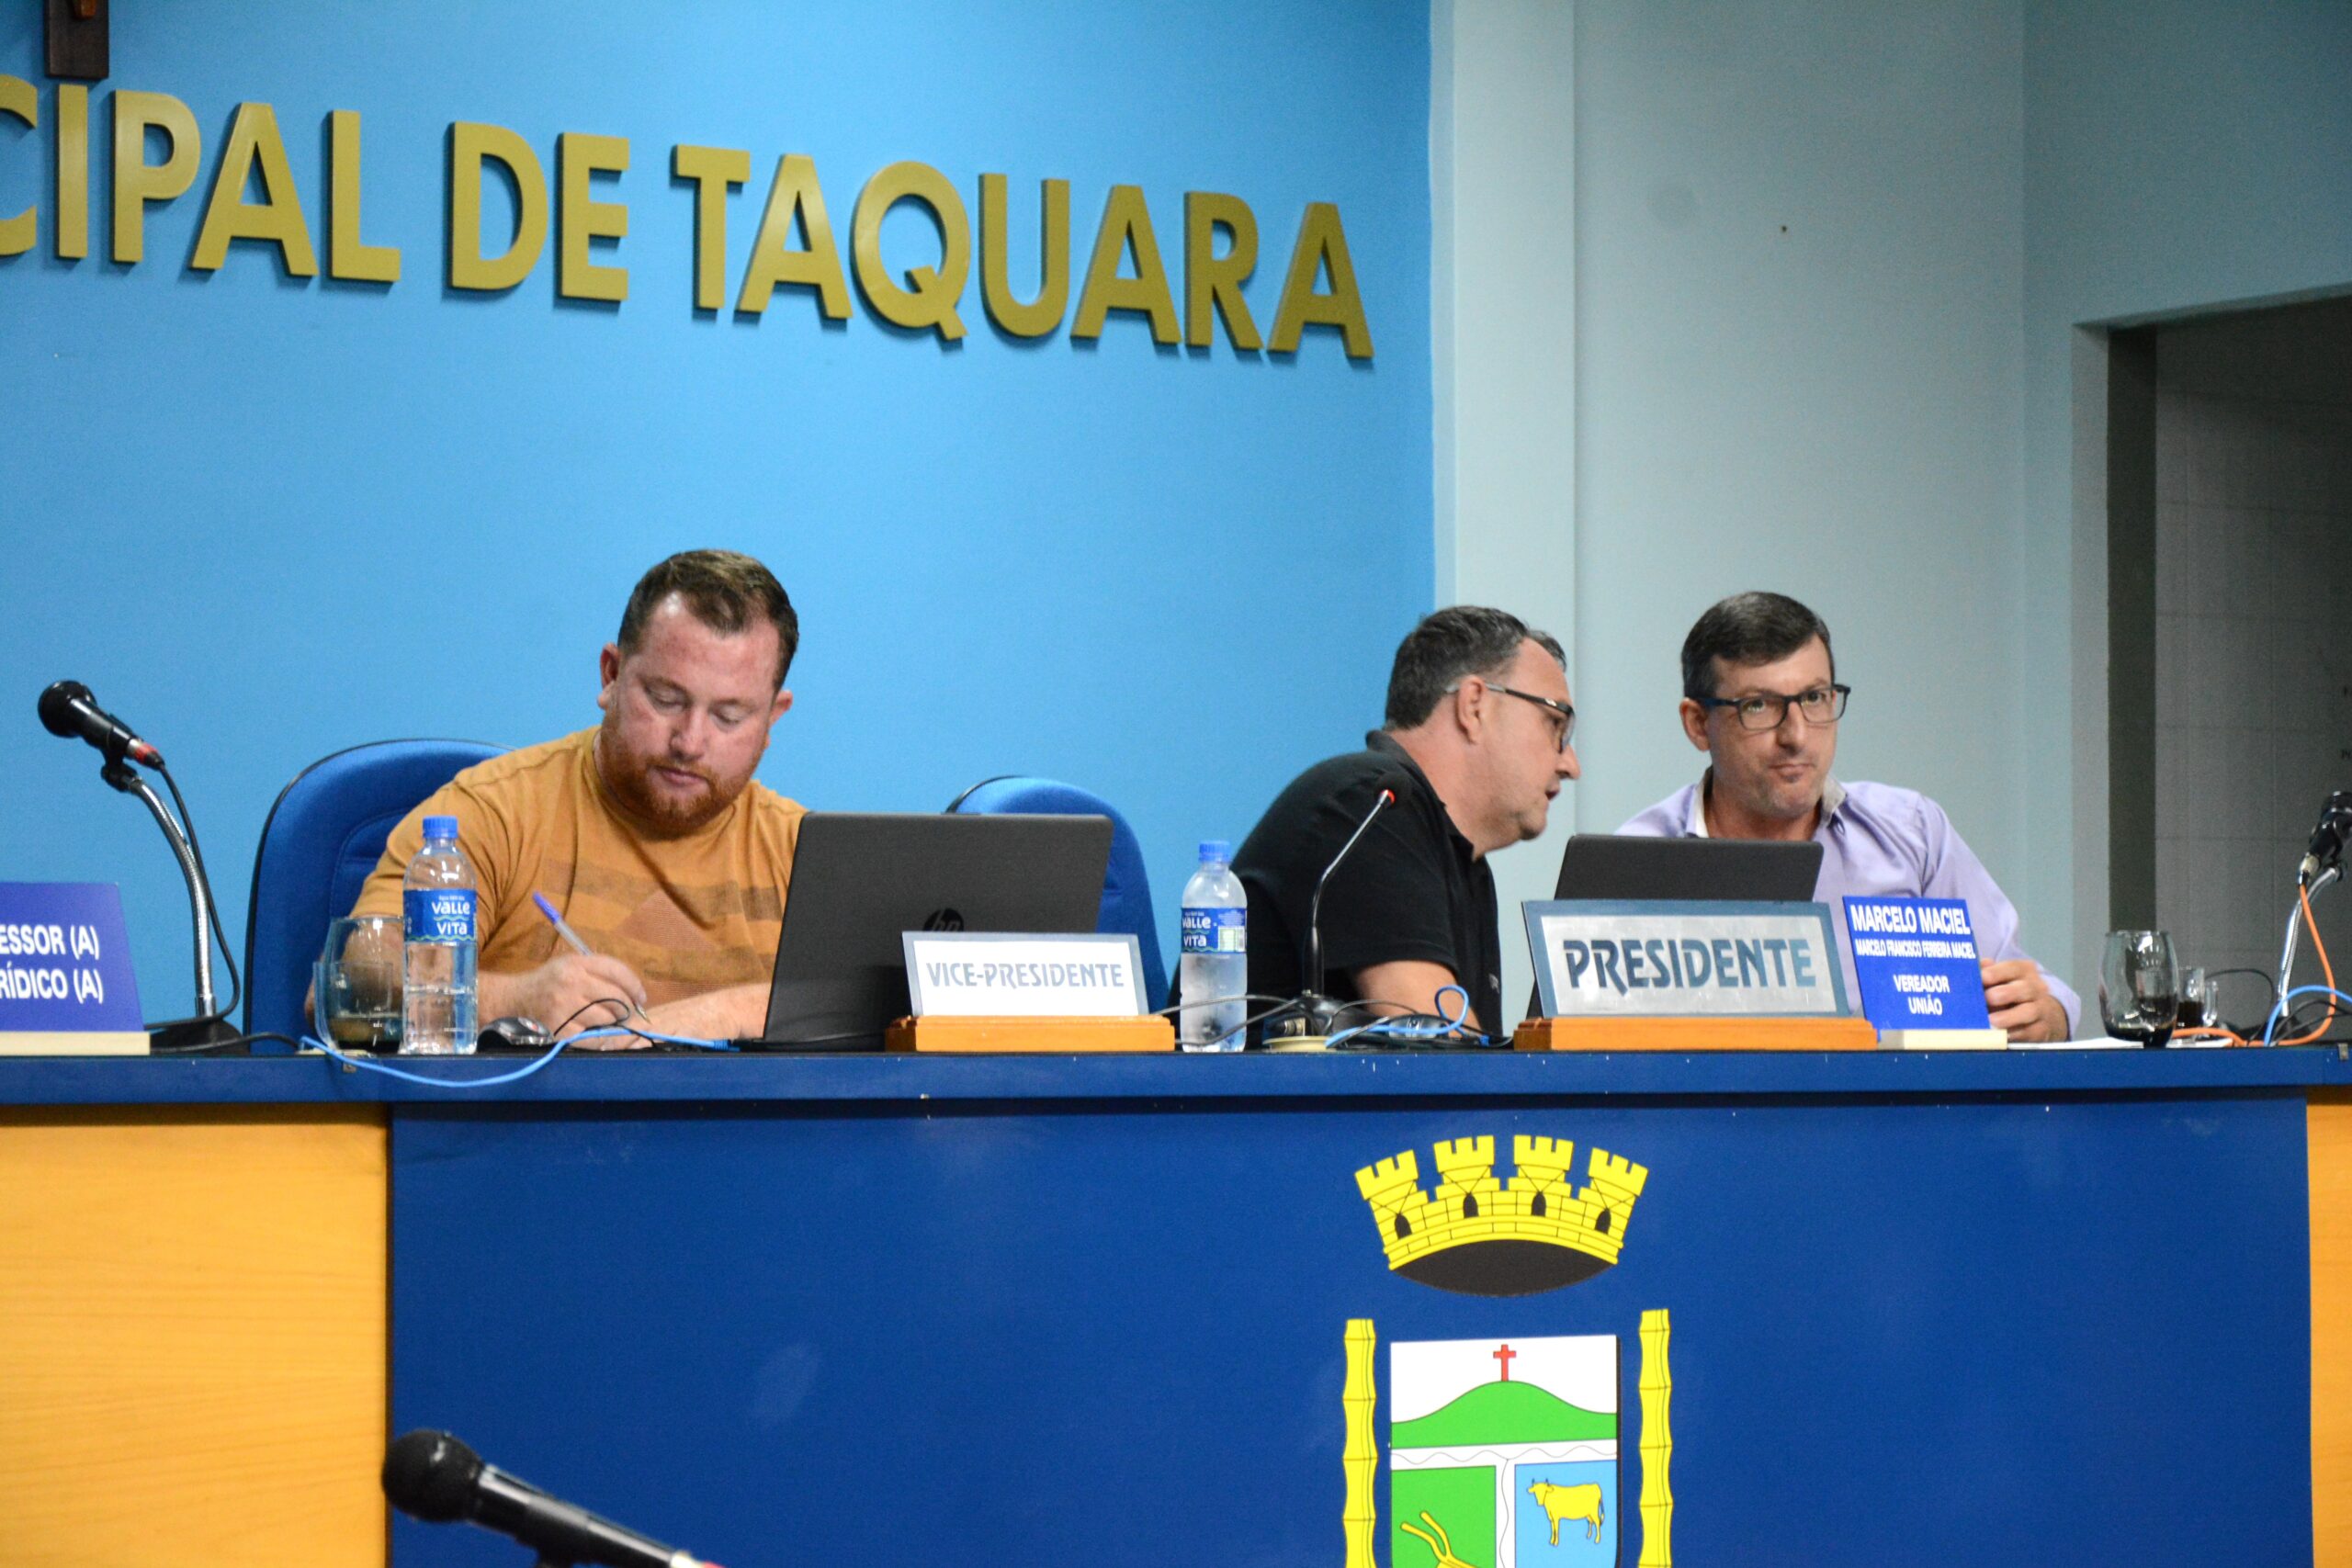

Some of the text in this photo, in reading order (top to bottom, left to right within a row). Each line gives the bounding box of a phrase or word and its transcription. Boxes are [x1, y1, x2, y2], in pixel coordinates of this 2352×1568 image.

[448, 120, 630, 301] DE
[672, 144, 1374, 358] TAQUARA
[1850, 905, 1971, 935] MARCELO MACIEL
[0, 924, 99, 961] ESSOR (A)
[1855, 939, 1976, 959] MARCELO FRANCISCO FERREIRA MACIEL
[0, 960, 104, 1004] RÍDICO (A)
[926, 962, 1124, 989] VICE-PRESIDENTE
[1563, 938, 1816, 997] PRESIDENTE
[1893, 975, 1950, 993] VEREADOR
[1908, 994, 1943, 1015] UNIÃO
